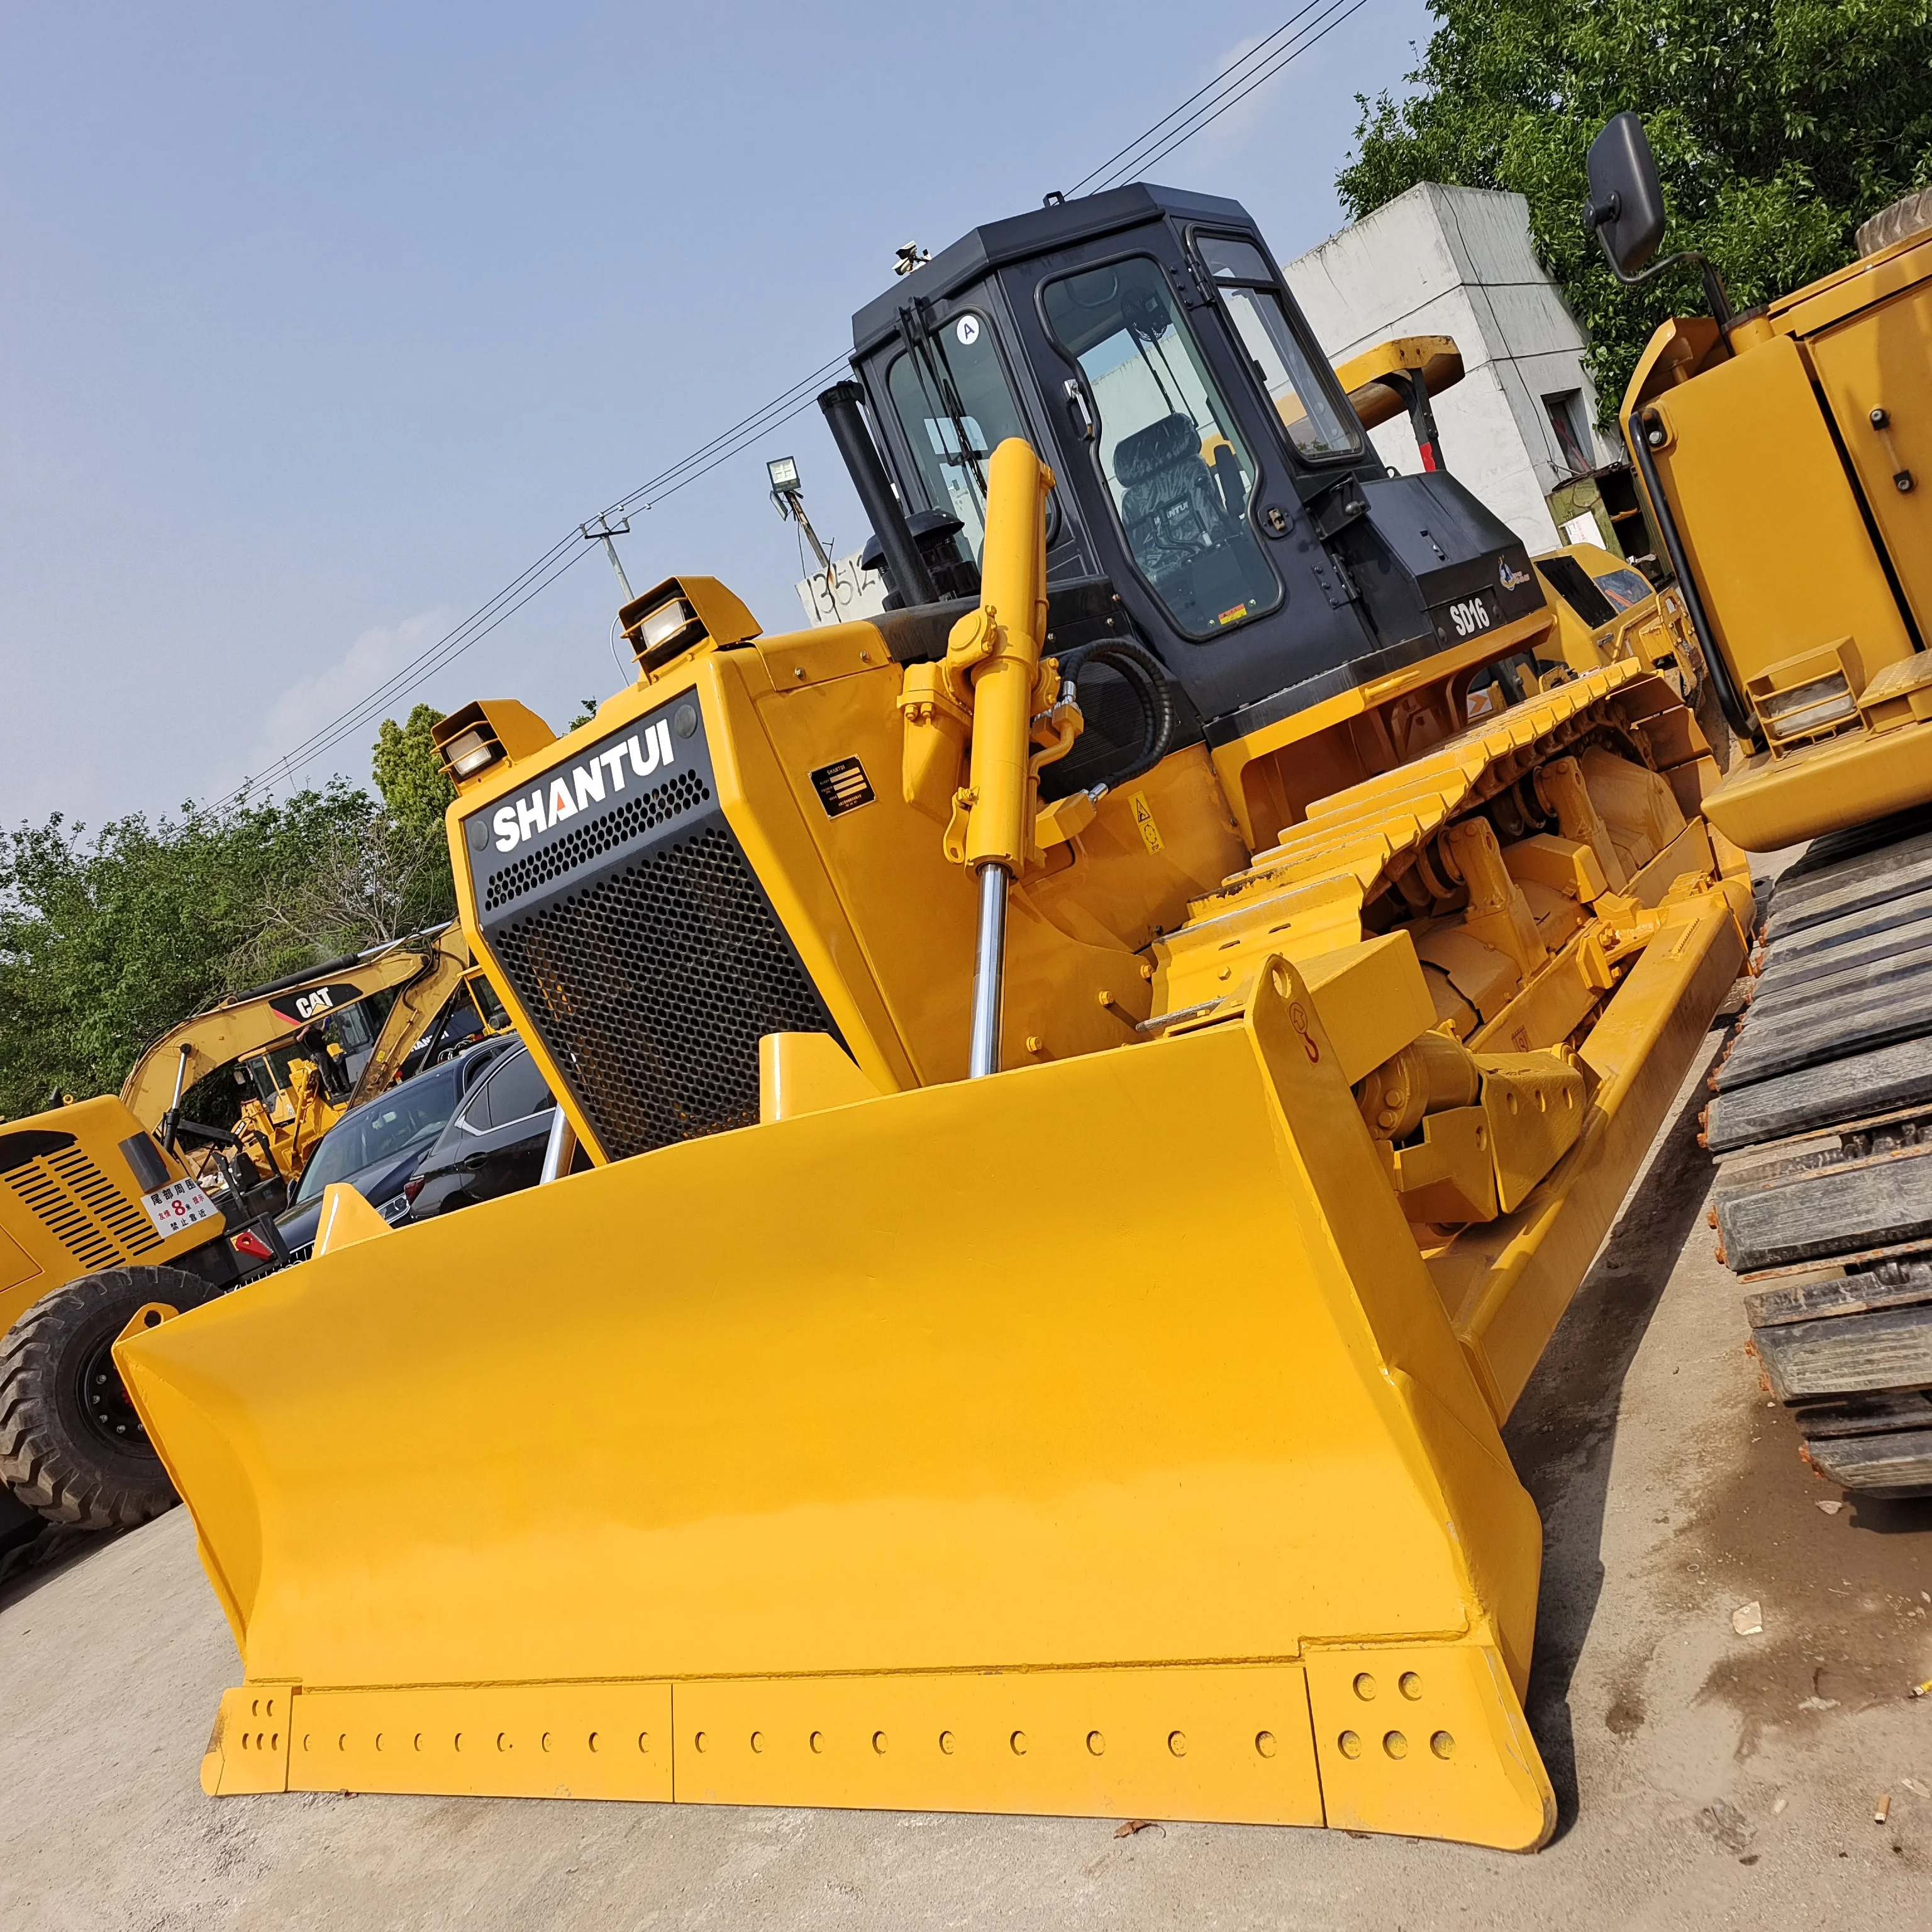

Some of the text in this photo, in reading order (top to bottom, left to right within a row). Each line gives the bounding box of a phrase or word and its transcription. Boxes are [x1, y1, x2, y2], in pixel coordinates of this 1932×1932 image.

[964, 323, 975, 340] A
[1450, 597, 1490, 636] SD16
[493, 718, 674, 852] SHANTUI
[296, 987, 333, 1018] CAT
[150, 1179, 197, 1206] 尾部周围
[170, 1209, 207, 1231] 禁止靠近
